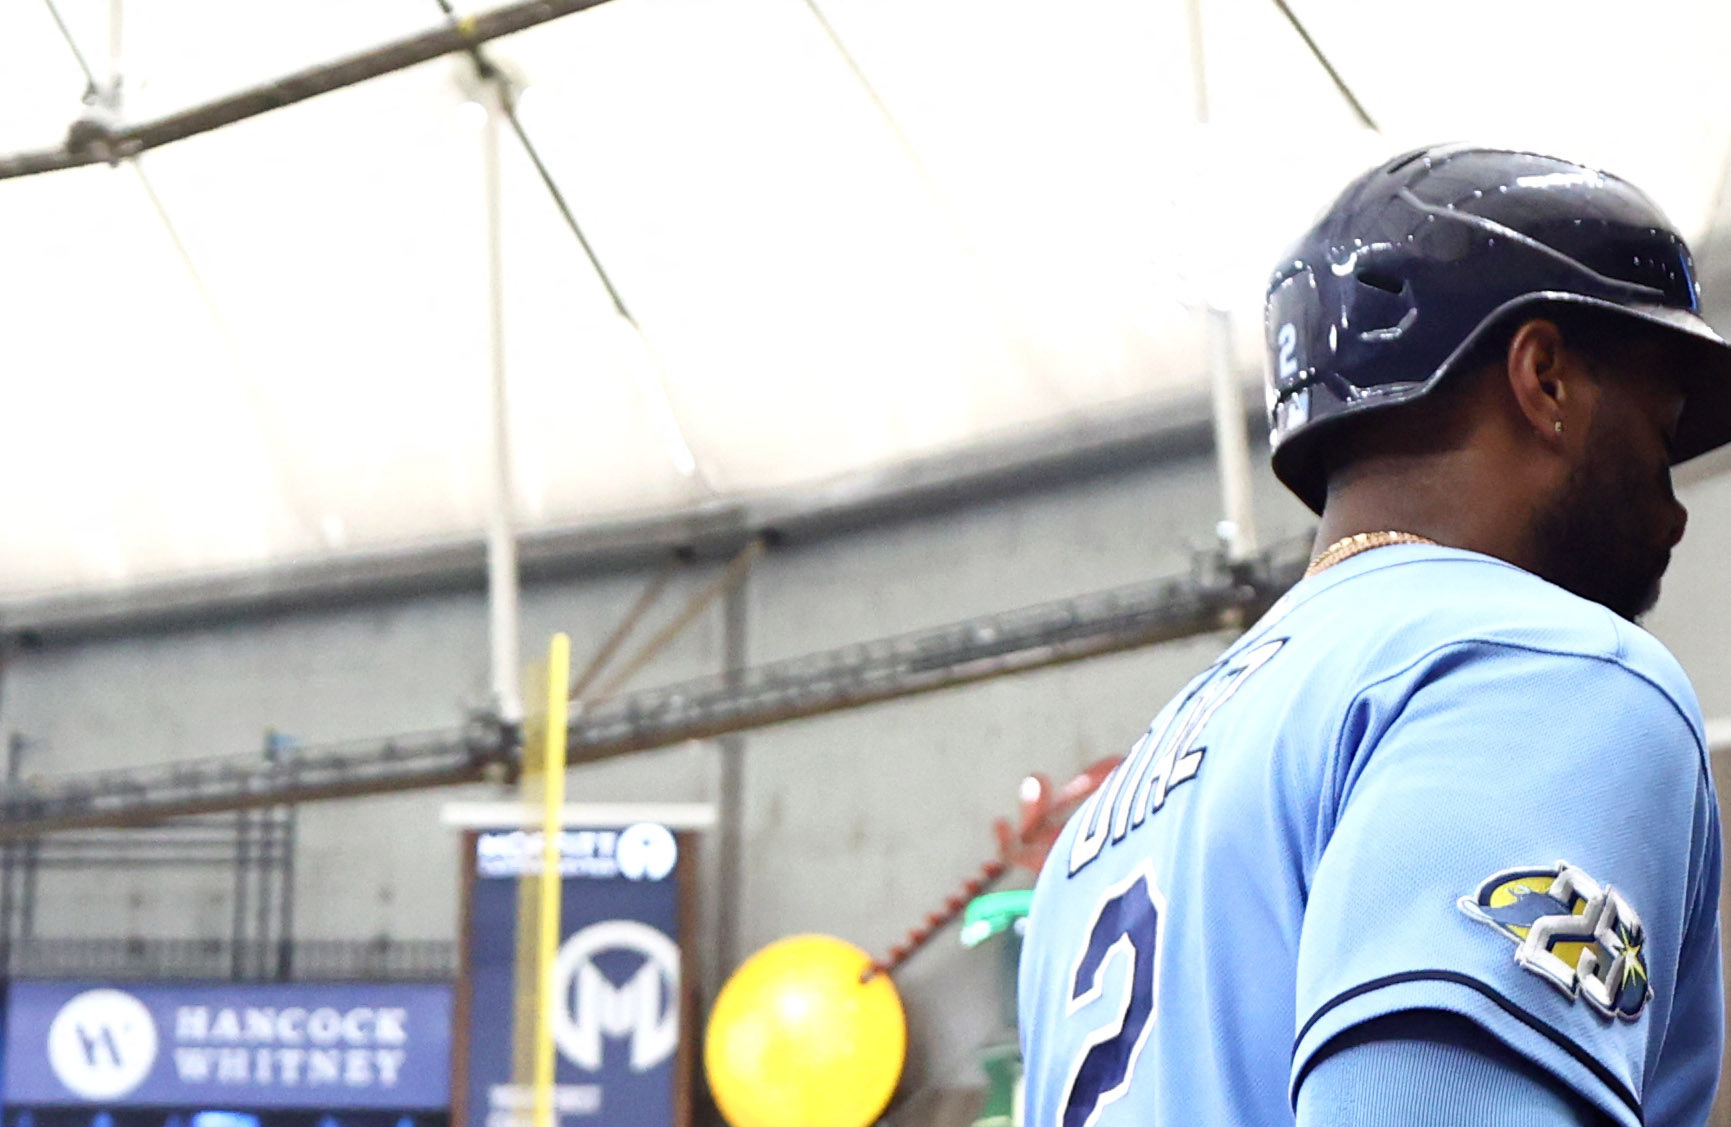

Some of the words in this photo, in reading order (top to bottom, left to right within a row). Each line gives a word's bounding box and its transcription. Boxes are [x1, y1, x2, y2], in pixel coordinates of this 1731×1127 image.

[1278, 322, 1298, 379] 2
[175, 1006, 408, 1045] HANCOCK
[173, 1046, 406, 1086] WHITNEY
